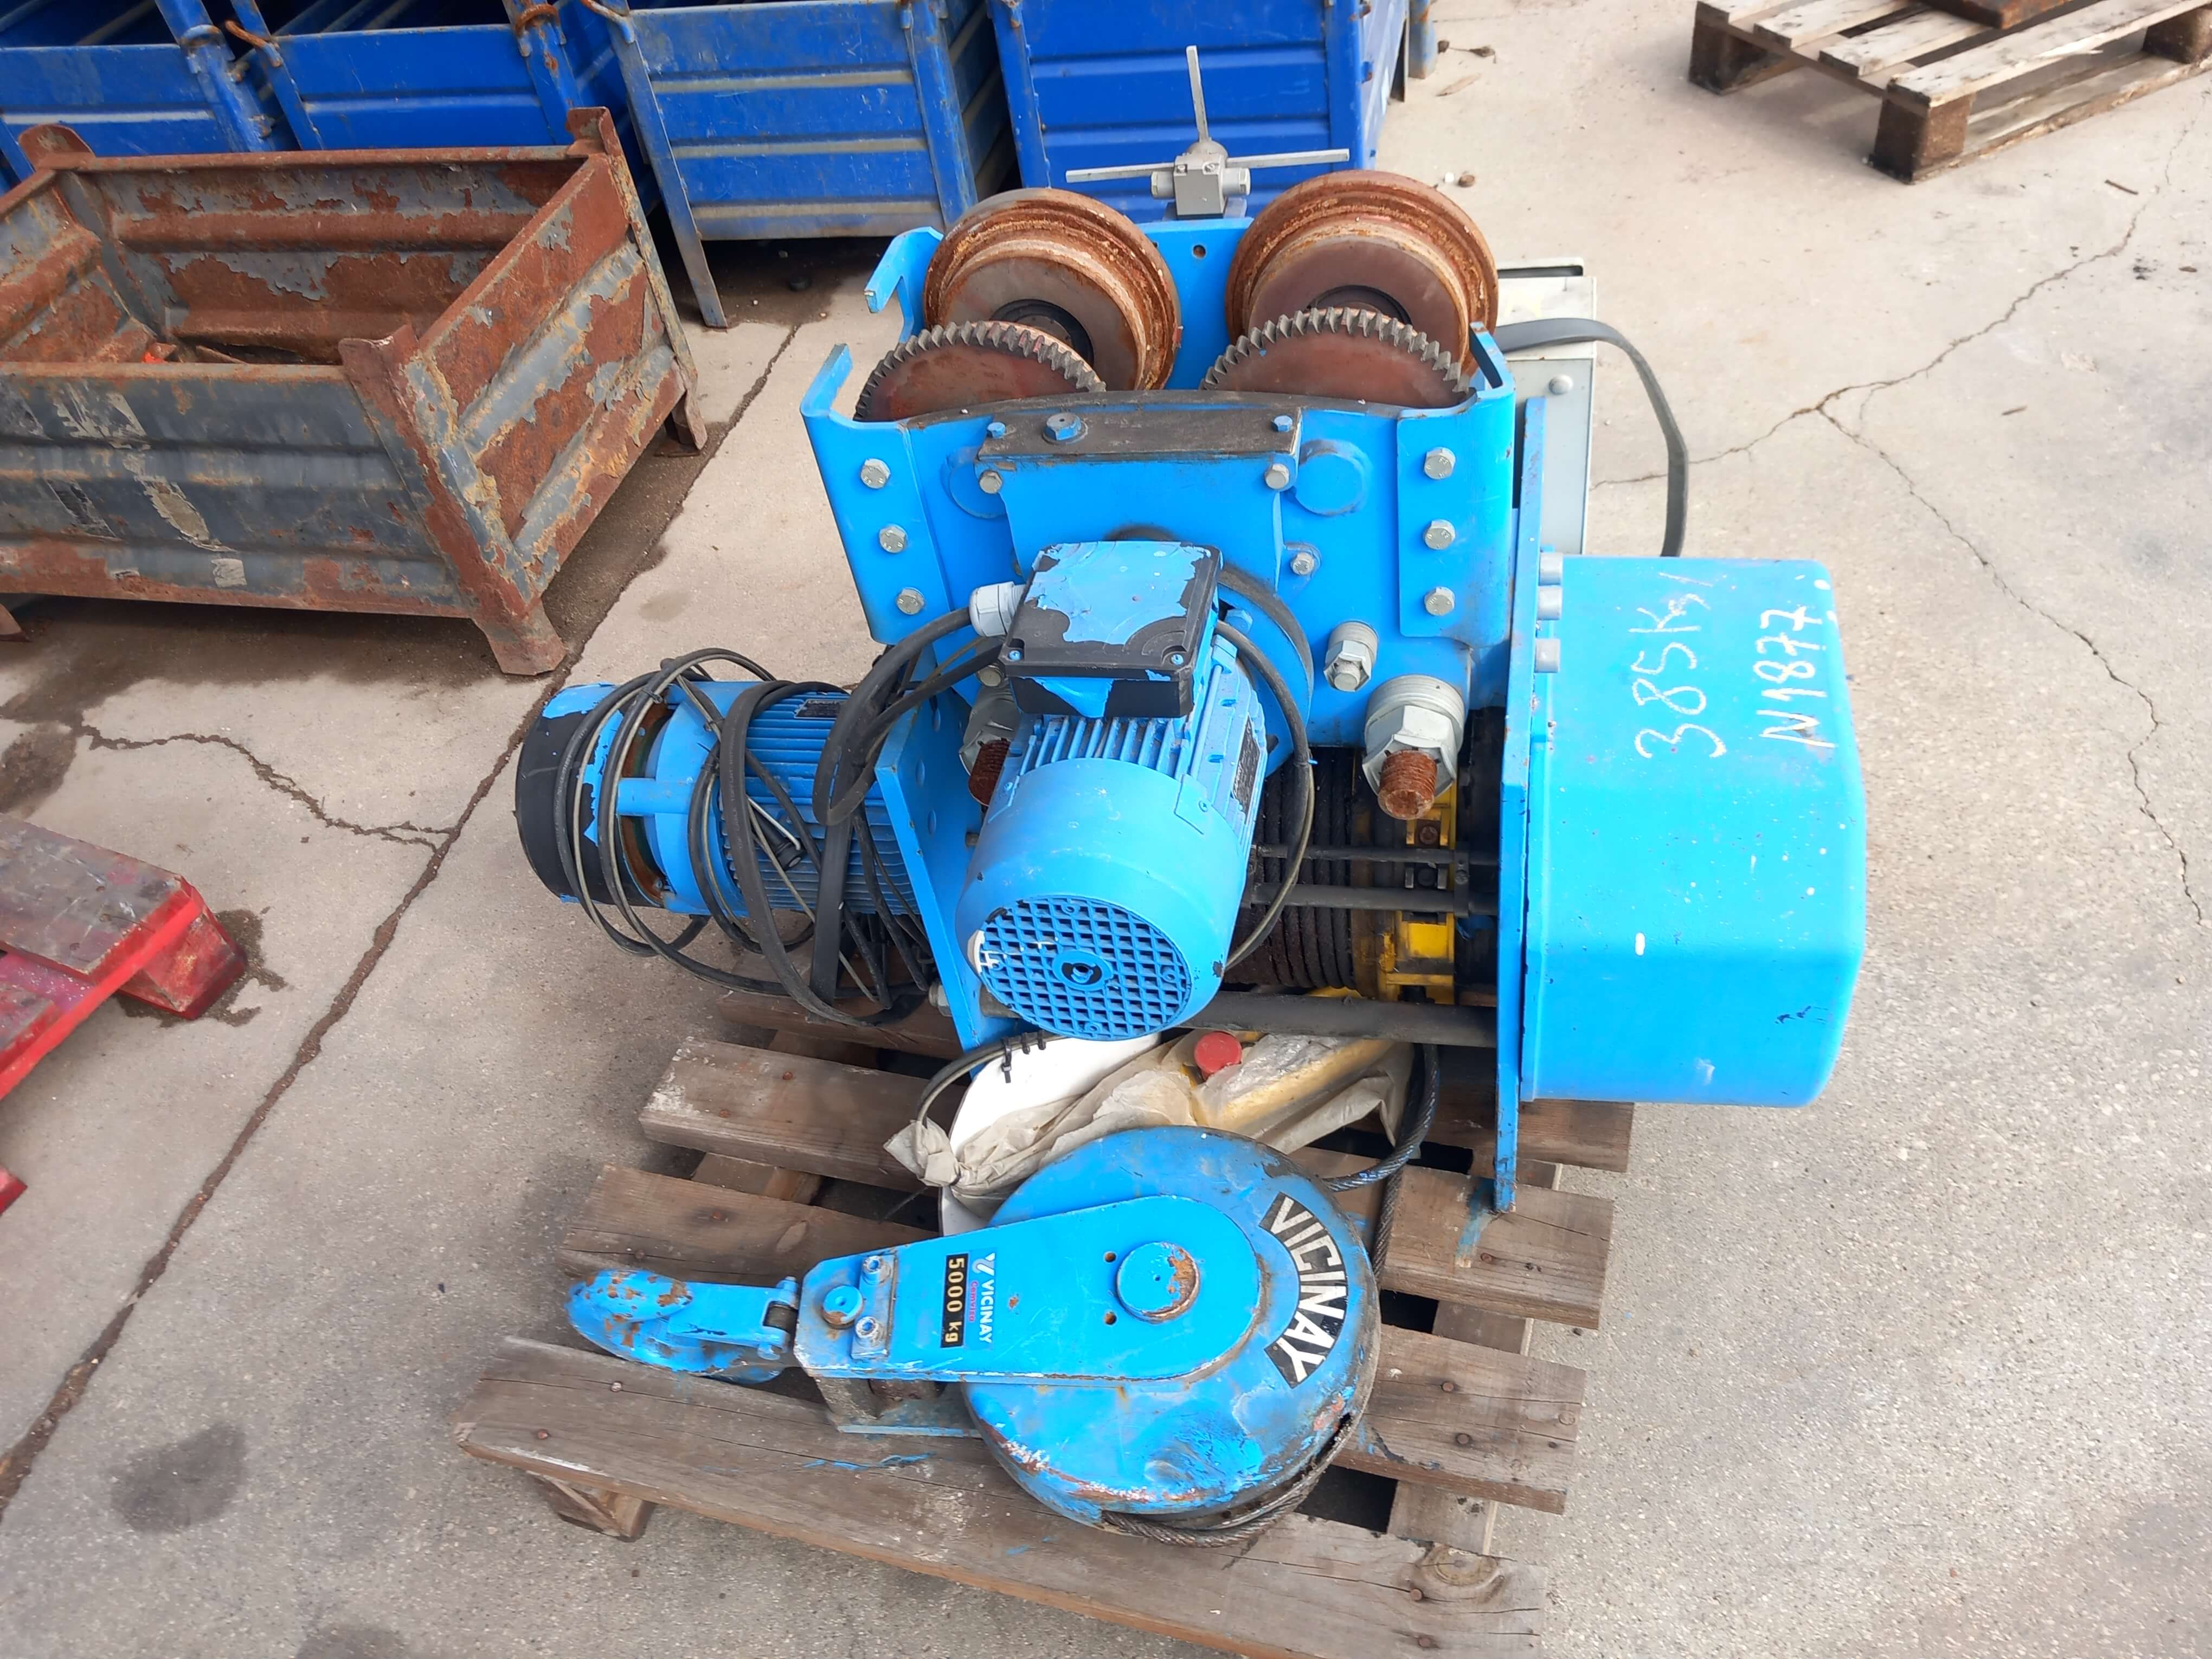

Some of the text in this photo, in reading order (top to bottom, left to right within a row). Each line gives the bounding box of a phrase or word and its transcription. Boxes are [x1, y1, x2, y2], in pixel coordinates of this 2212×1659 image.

[944, 1257, 964, 1343] 5000 kg
[979, 1279, 995, 1343] VICINAY
[1270, 1196, 1347, 1382] VICINAY
